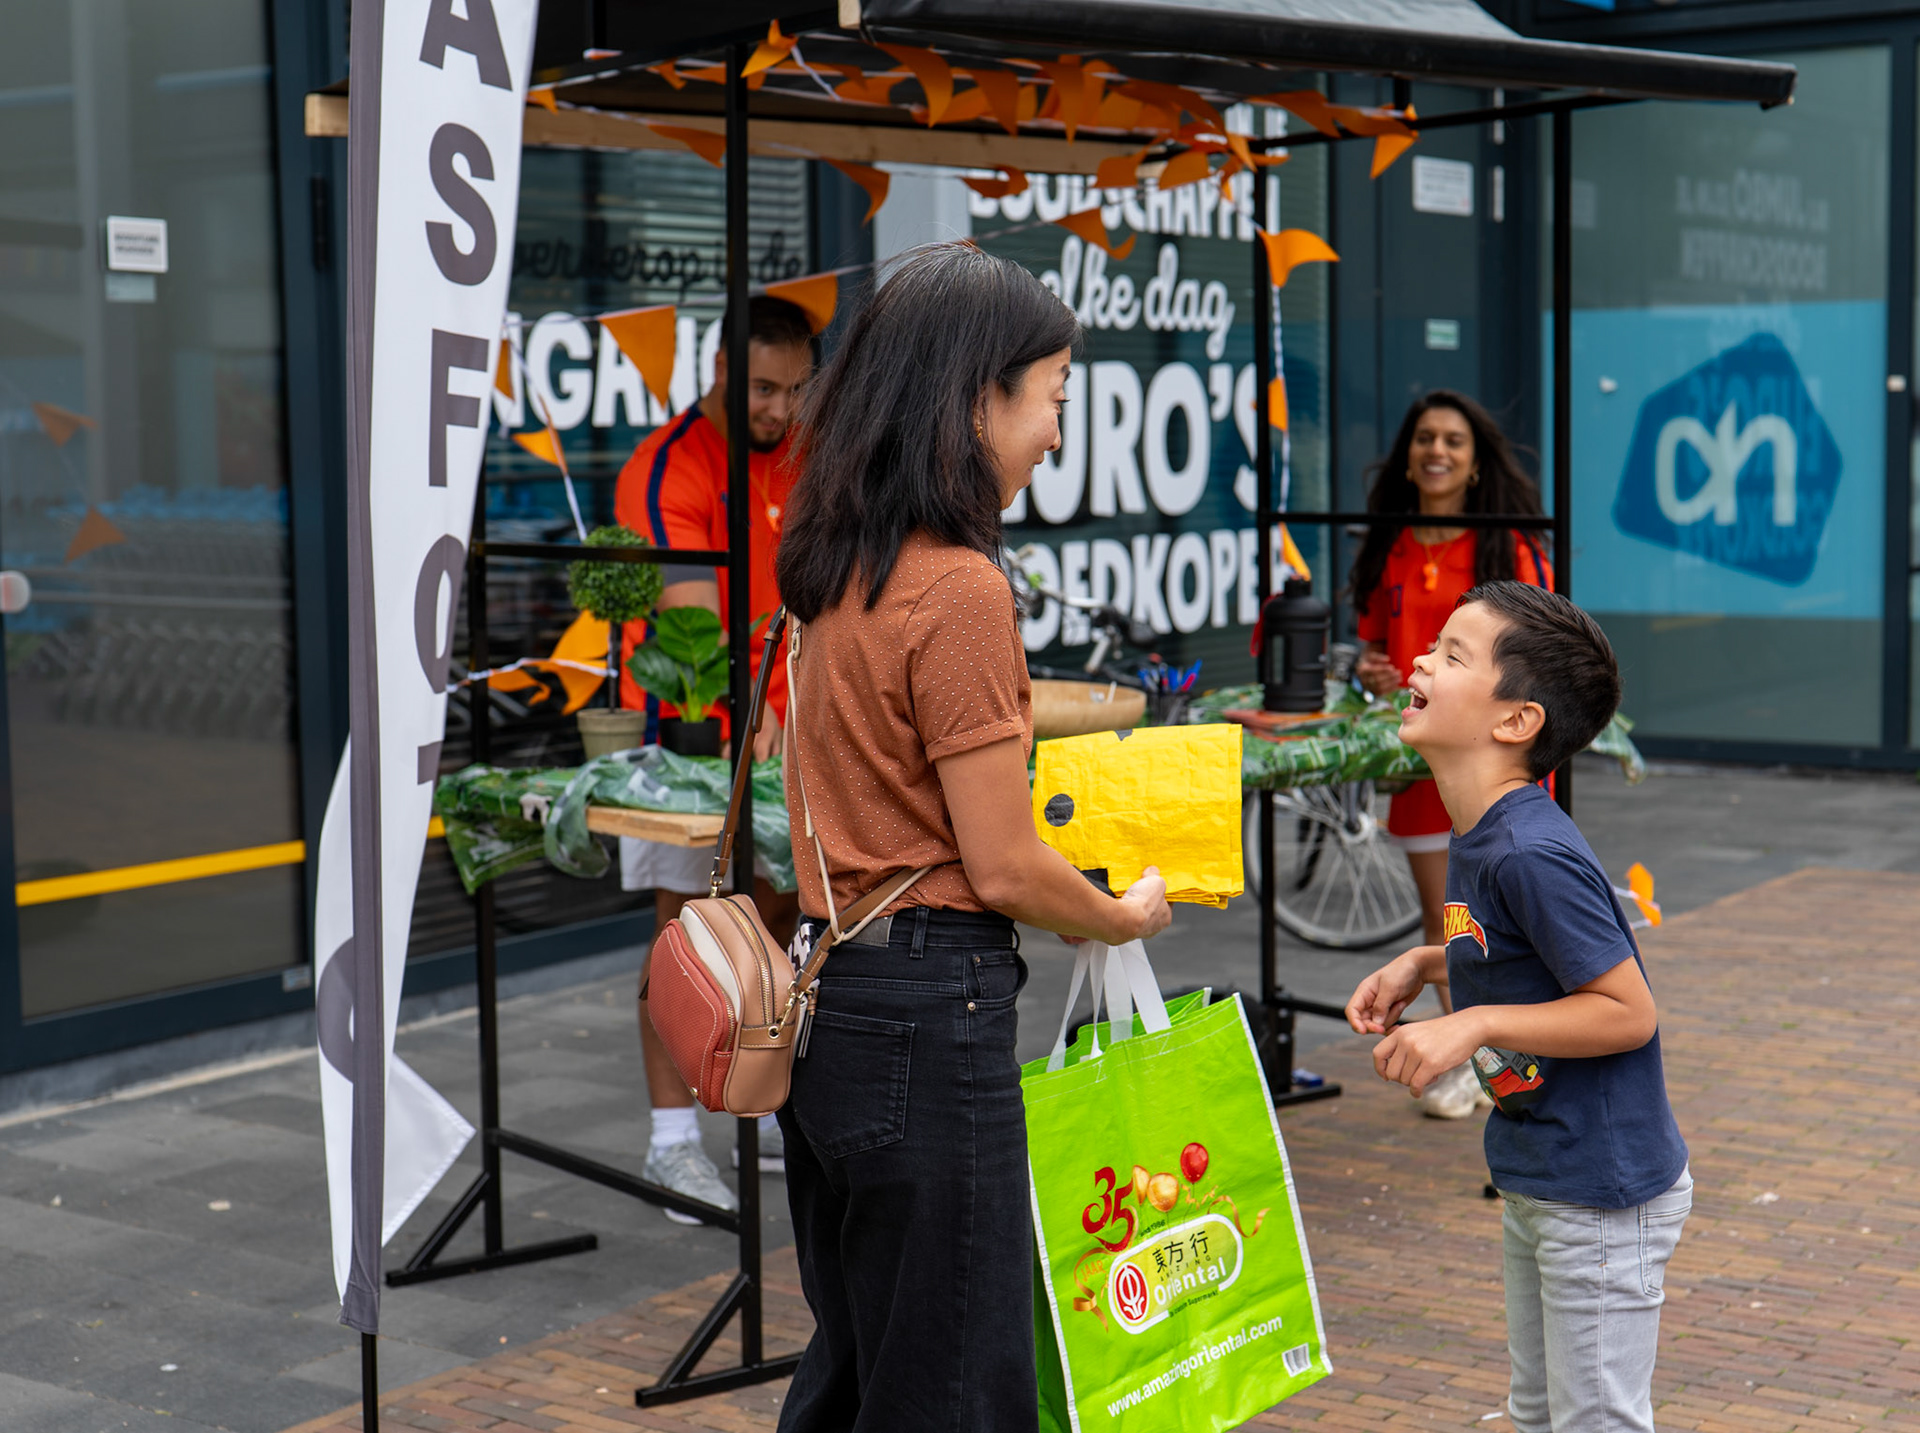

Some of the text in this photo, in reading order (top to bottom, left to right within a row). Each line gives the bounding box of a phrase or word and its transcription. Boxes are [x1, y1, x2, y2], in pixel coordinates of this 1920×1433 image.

[1144, 242, 1235, 361] dag
[1082, 1166, 1134, 1253] 35
[1080, 1259, 1105, 1282] JAAR
[1152, 1230, 1209, 1273] 東方行
[1154, 1257, 1227, 1306] Oriental
[1107, 1316, 1283, 1418] www.amazingoriental.com
